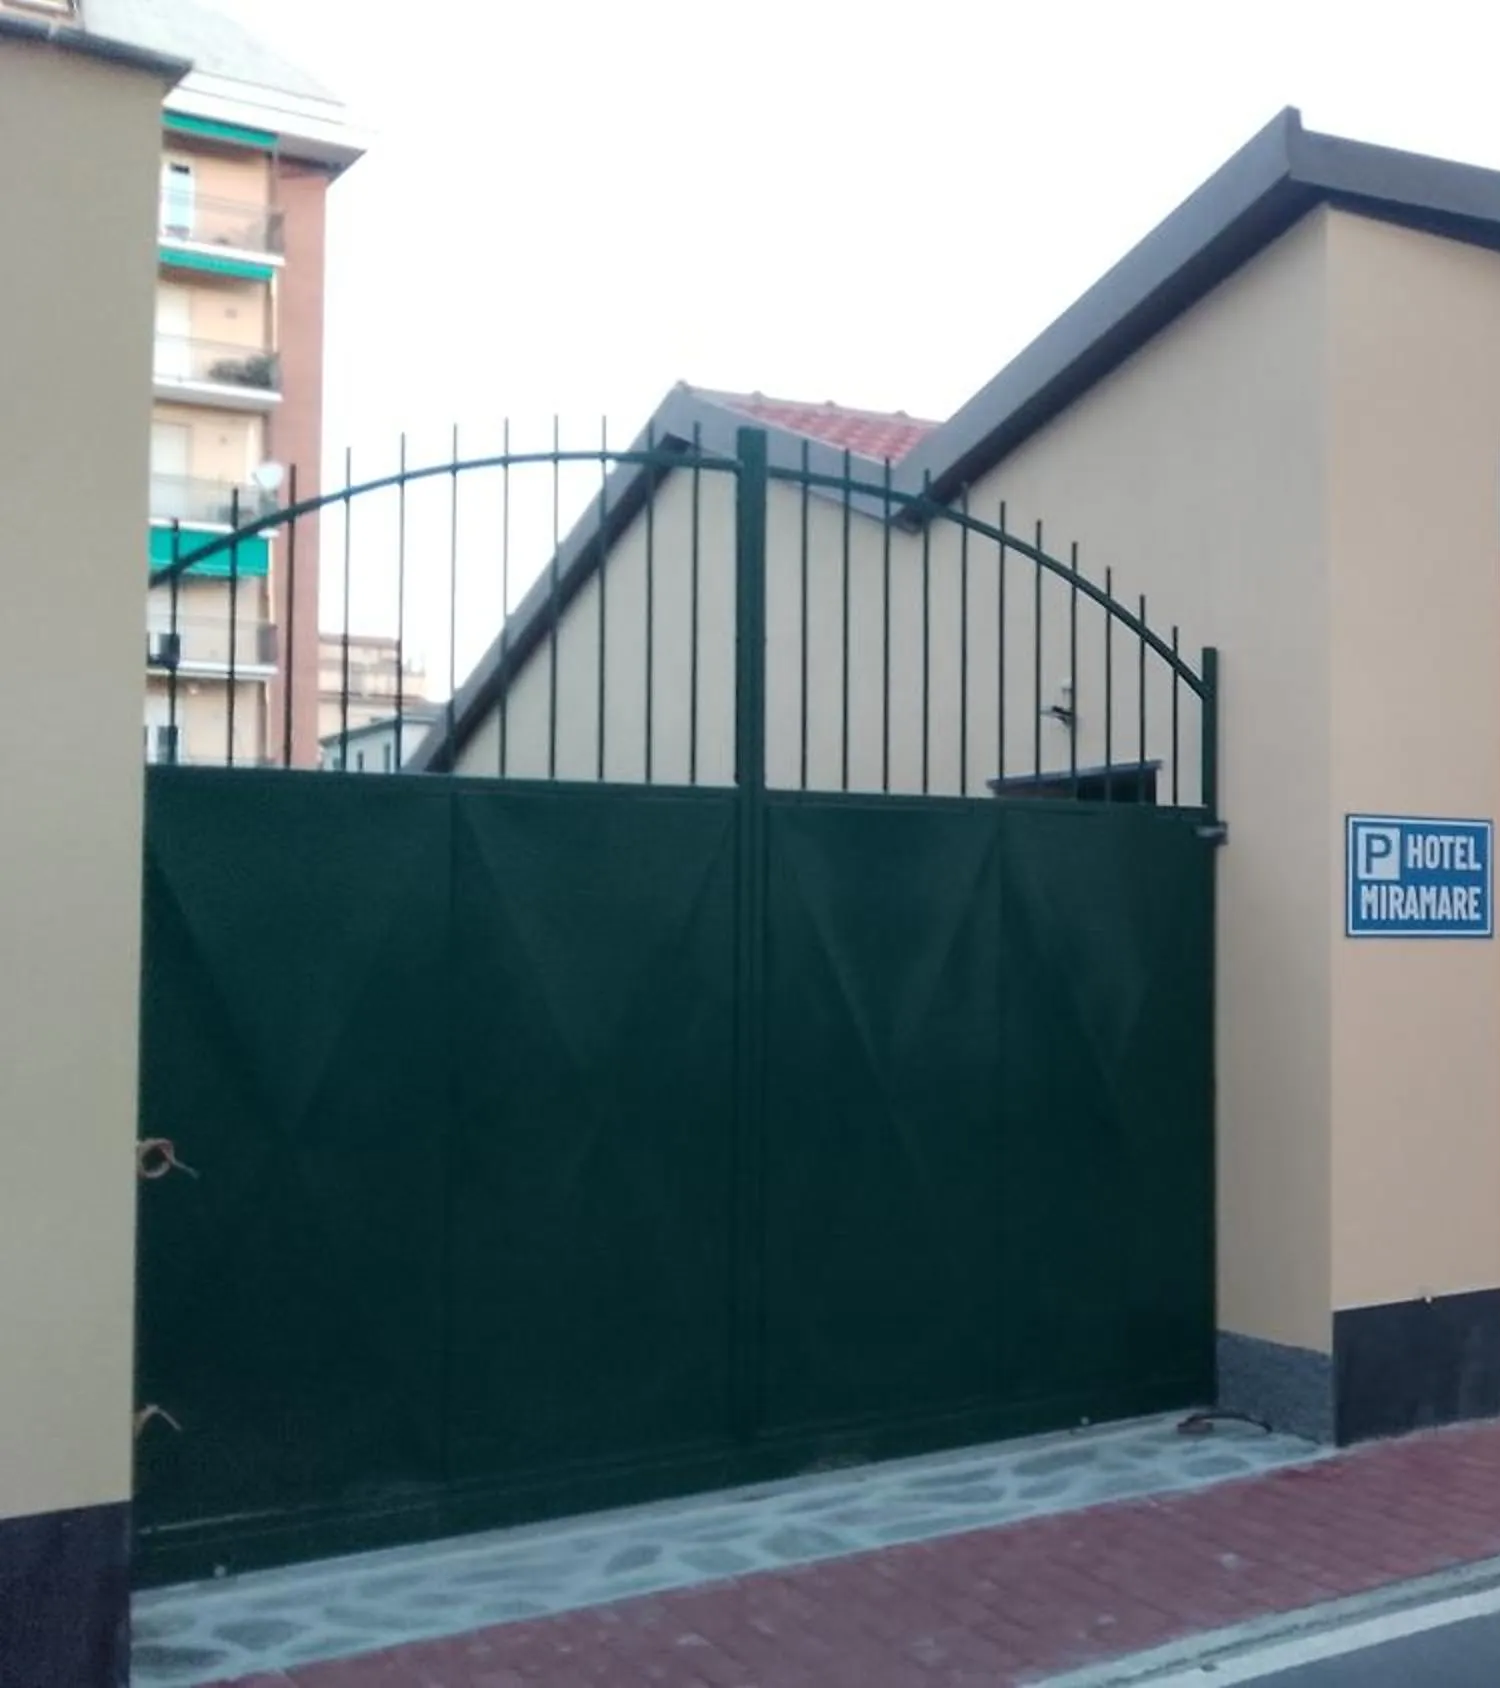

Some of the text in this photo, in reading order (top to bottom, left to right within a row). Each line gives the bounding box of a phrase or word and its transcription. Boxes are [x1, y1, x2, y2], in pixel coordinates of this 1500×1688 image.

[1365, 833, 1482, 875] P HOTEL
[1360, 884, 1482, 921] MIRAMARE
